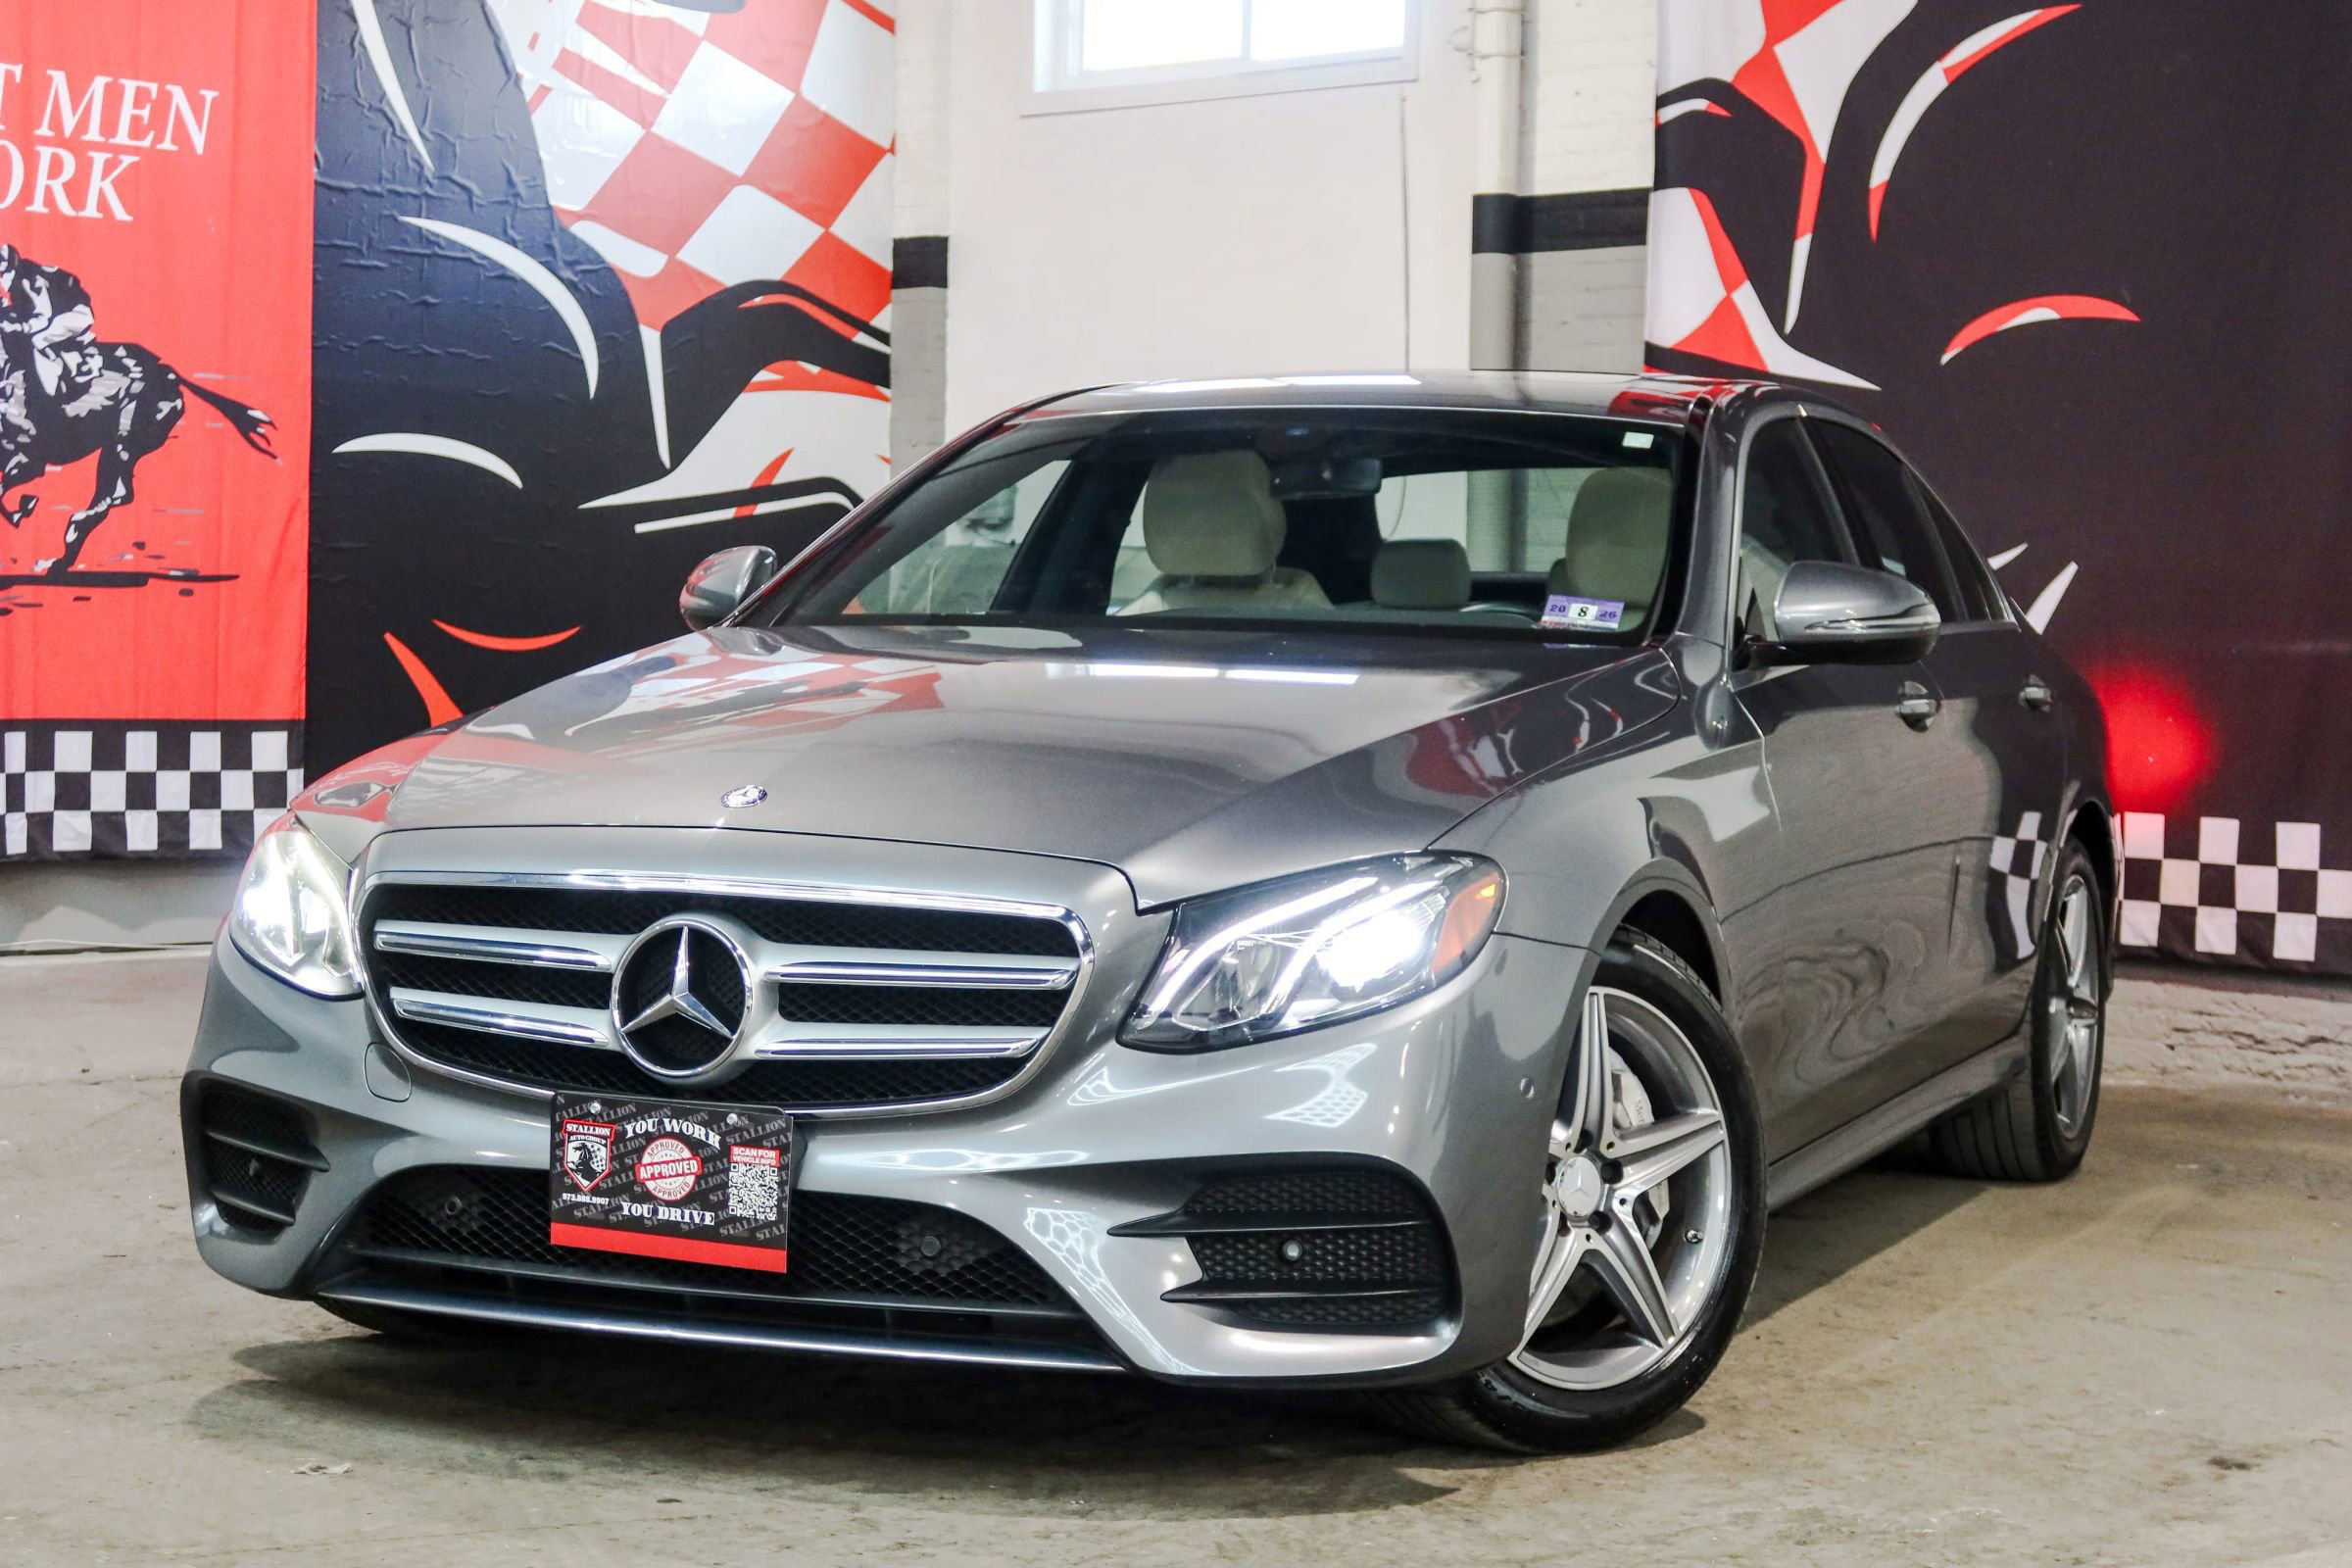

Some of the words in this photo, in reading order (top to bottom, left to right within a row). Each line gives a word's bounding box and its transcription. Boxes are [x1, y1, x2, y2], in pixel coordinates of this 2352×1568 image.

[33, 69, 220, 156] MEN
[1549, 604, 1566, 612] 20
[1578, 607, 1589, 617] 8
[566, 1123, 612, 1136] STALLION
[624, 1118, 659, 1139] YOU
[662, 1117, 721, 1151] WORK
[586, 1134, 607, 1145] GROUP
[647, 1141, 685, 1157] APPROVED
[732, 1147, 758, 1156] SCAN
[758, 1150, 776, 1158] FOR
[732, 1154, 761, 1163] VEHICLE
[639, 1159, 699, 1180] APPROVED
[652, 1181, 691, 1199] APPROVED
[620, 1200, 655, 1217] YOU
[657, 1205, 715, 1226] DRIVE
